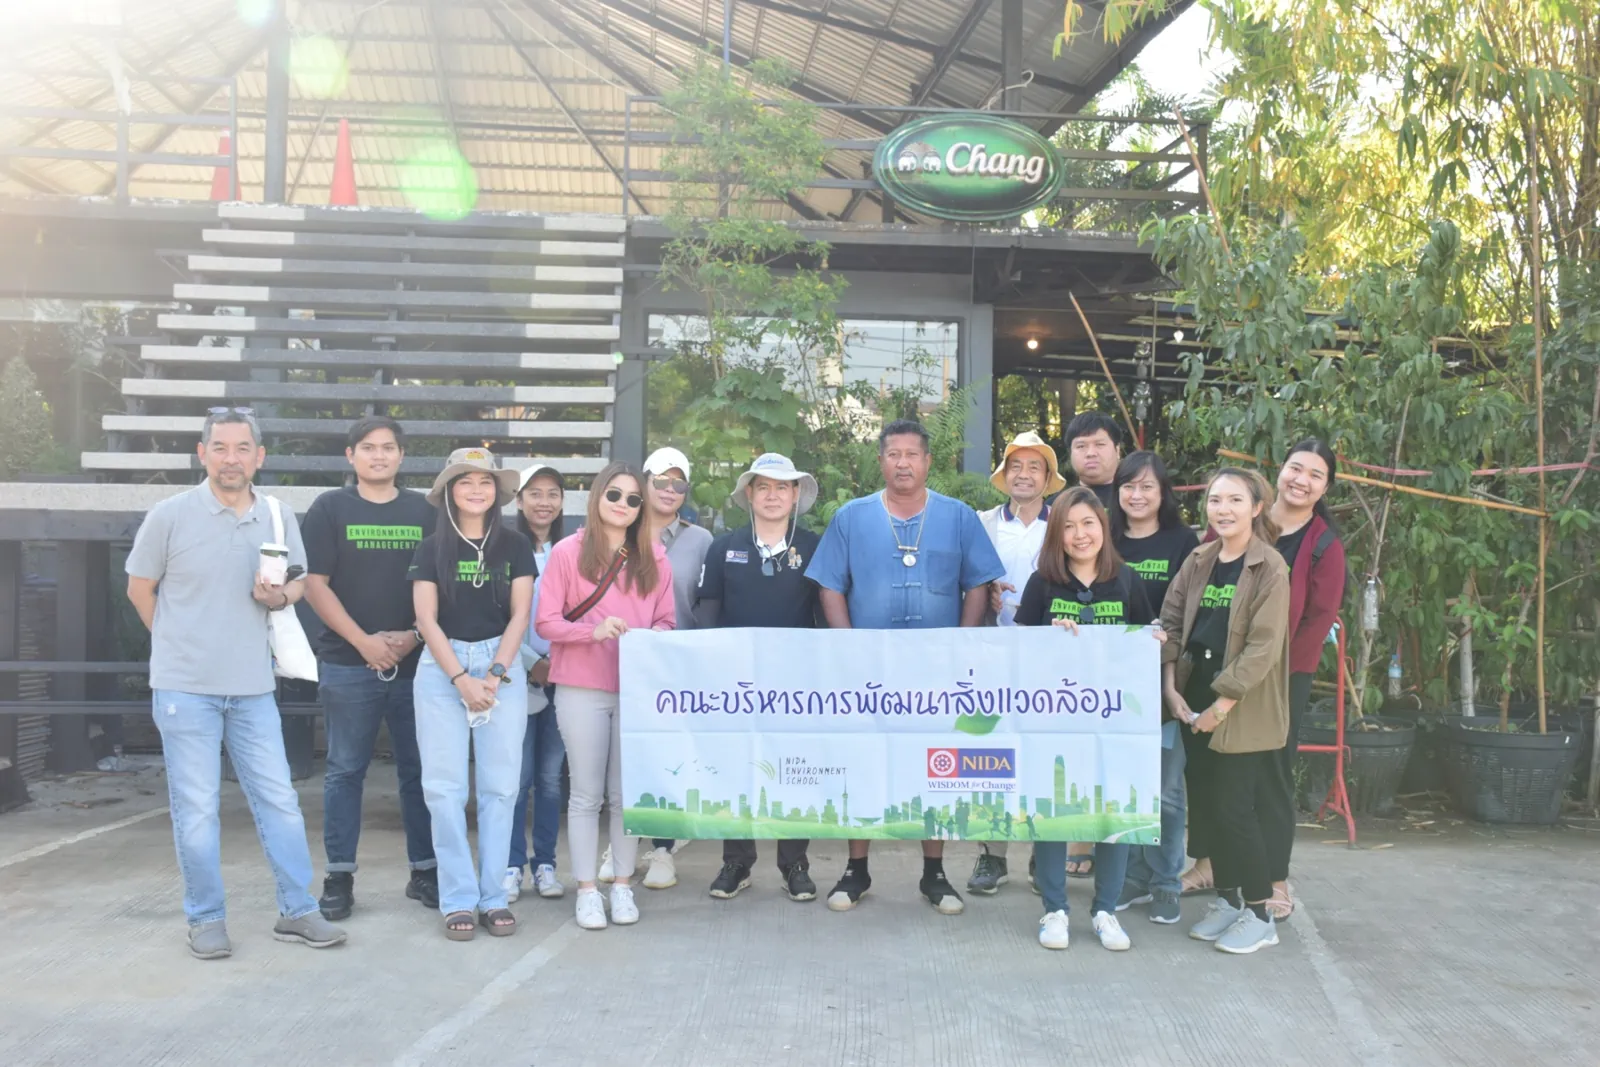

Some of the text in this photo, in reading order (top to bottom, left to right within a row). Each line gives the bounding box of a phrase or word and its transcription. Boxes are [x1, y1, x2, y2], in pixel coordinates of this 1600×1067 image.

[945, 142, 1046, 184] Chang
[349, 528, 421, 538] ENVIRONMENTAL
[357, 540, 416, 549] MANAGEMENT
[656, 668, 1122, 719] คณะบริหารการพัฒนาสิ่งแวดล้อม
[785, 757, 807, 765] NIDA
[962, 755, 1012, 771] NIDA
[785, 767, 847, 775] ENVIRONMENT
[785, 776, 820, 785] SCHOOL
[927, 781, 969, 789] WISDOM
[981, 781, 1016, 791] Change
